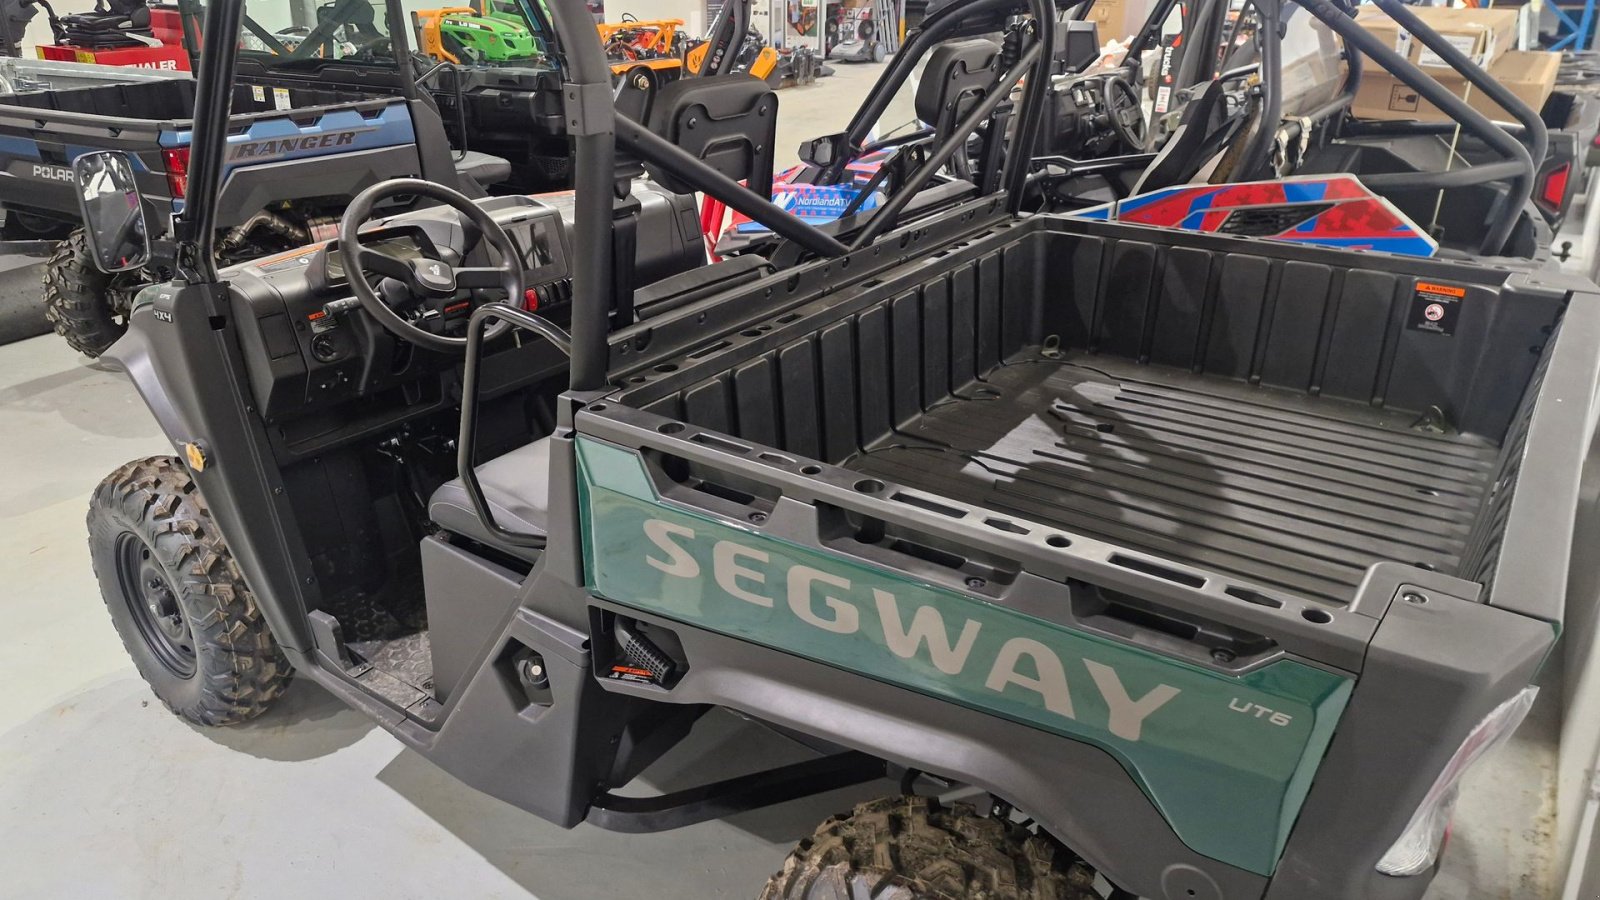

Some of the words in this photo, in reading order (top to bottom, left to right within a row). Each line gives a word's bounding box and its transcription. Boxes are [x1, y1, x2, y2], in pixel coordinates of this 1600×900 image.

[124, 60, 177, 70] HALER
[233, 131, 356, 159] RANGER
[643, 519, 1182, 742] SEGWAY
[1228, 697, 1293, 727] UT6
